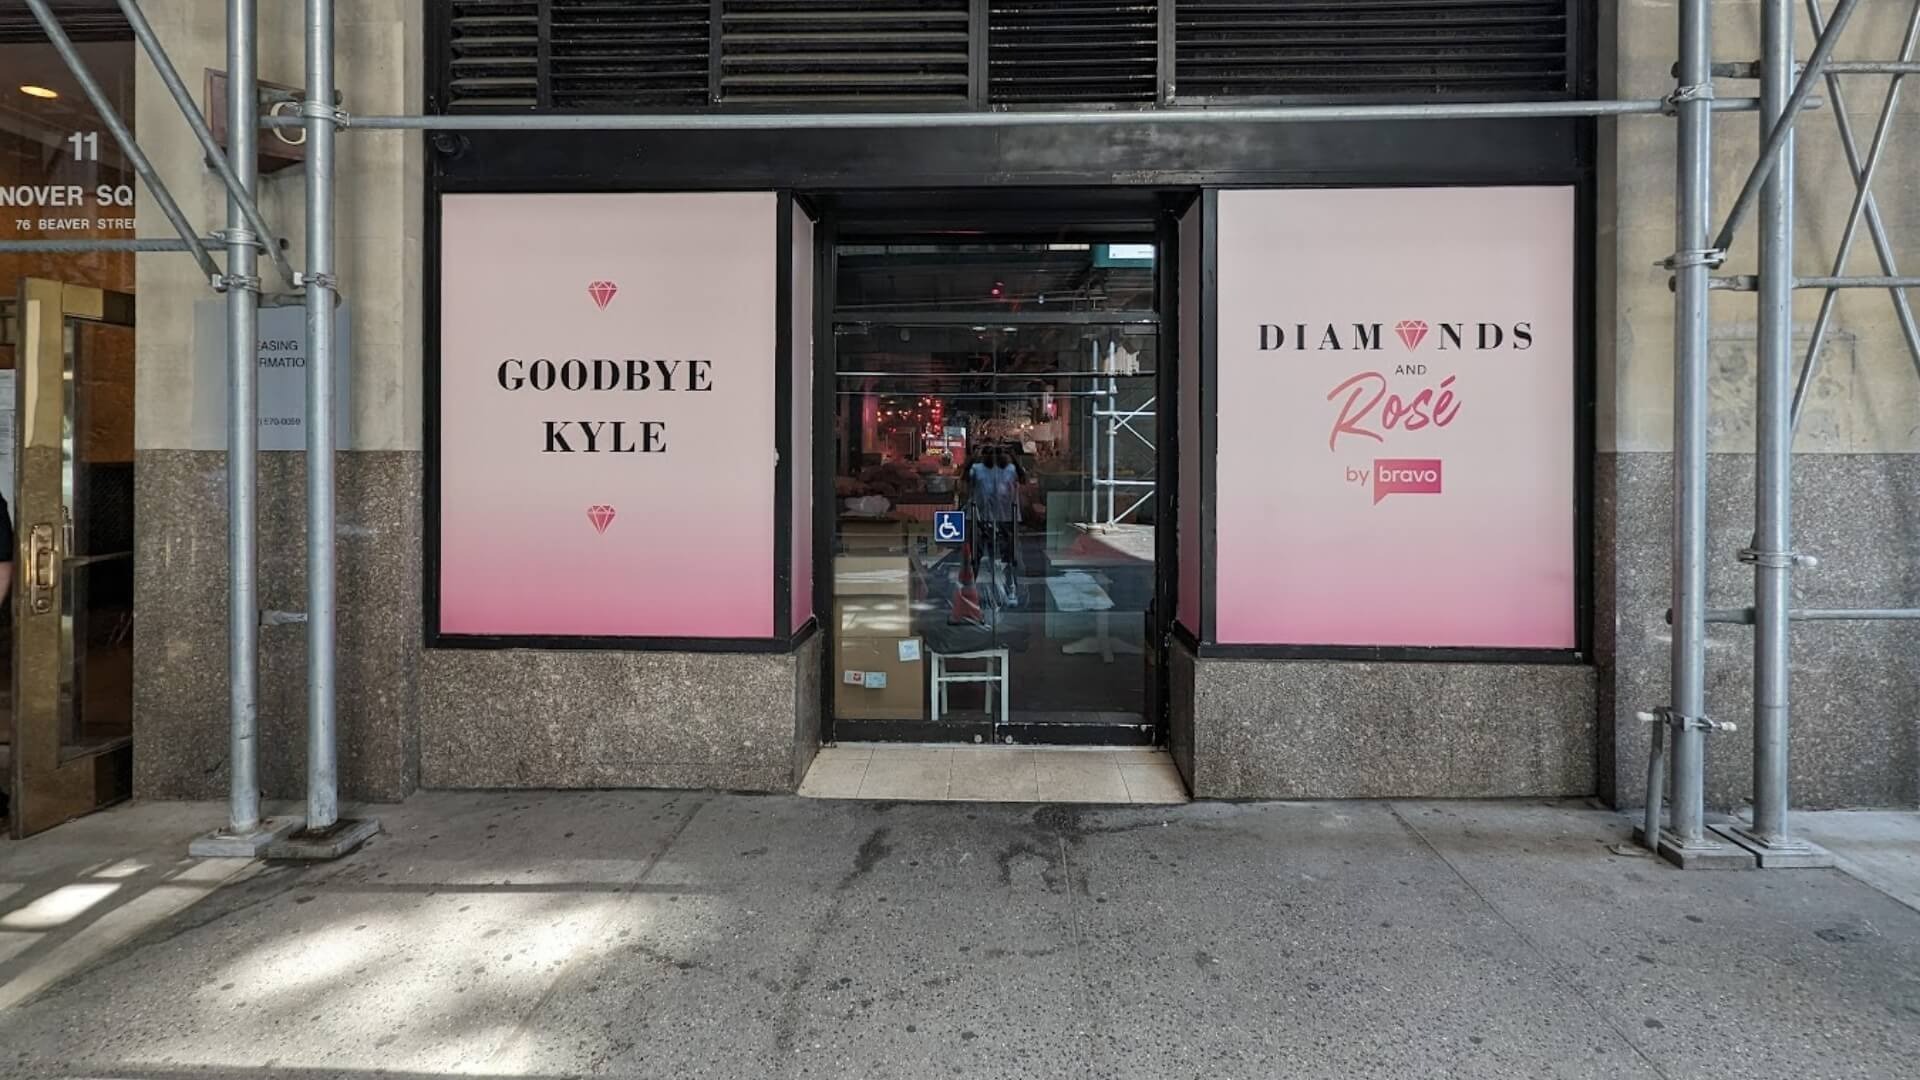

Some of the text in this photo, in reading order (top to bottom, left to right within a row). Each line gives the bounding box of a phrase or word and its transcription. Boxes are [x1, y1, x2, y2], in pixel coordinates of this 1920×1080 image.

[68, 131, 98, 161] 11
[0, 184, 134, 207] NOVER SQ
[16, 219, 31, 230] 76
[38, 218, 90, 230] BEAVER
[259, 357, 307, 368] RMATIO
[1395, 364, 1427, 376] AND
[497, 358, 713, 391] GOODBYE
[1327, 371, 1462, 452] Rosé
[541, 421, 667, 453] KYLE
[1346, 465, 1438, 486] by bravo
